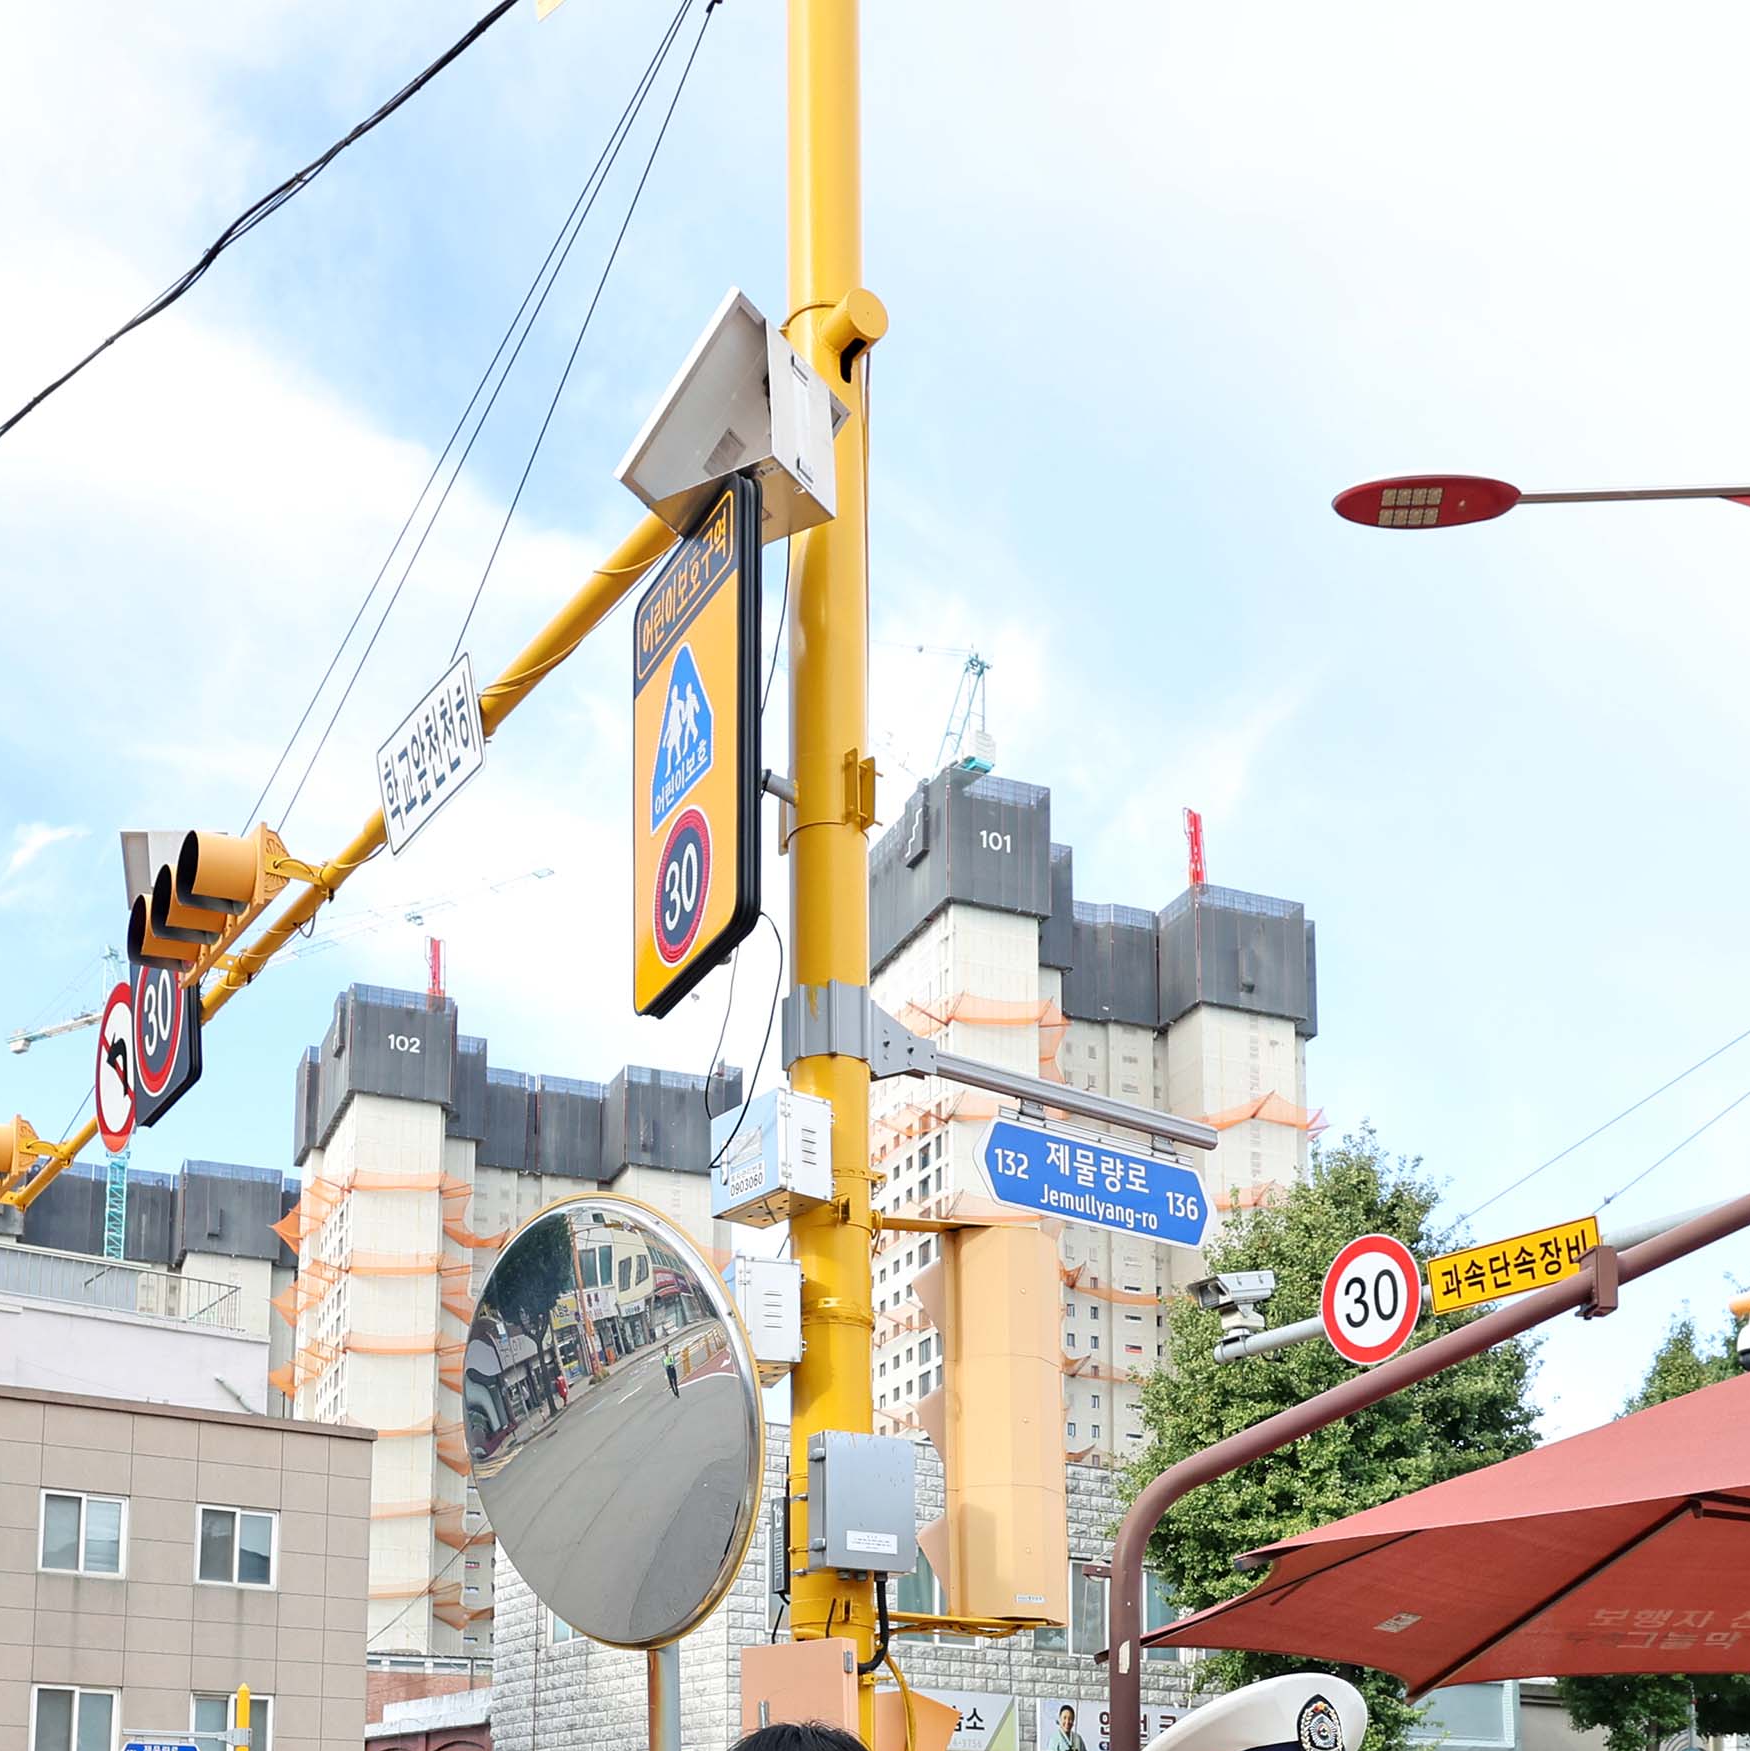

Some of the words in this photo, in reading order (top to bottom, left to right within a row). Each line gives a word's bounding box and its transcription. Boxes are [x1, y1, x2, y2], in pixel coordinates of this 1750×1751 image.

[642, 507, 728, 656] 어린이보호구역
[384, 671, 477, 830] 학교앞천천히
[655, 744, 708, 815] 어린이보호
[980, 830, 1011, 854] 101
[665, 842, 699, 931] 30
[144, 967, 172, 1057] 30
[387, 1034, 421, 1054] 102
[730, 1172, 763, 1197] 0903060
[995, 1146, 1030, 1181] 132
[1046, 1141, 1150, 1195] 제물량로
[1166, 1191, 1199, 1220] 136
[1039, 1183, 1159, 1231] Jemullyang-ro
[1344, 1268, 1399, 1329] 30
[1440, 1231, 1589, 1299] 과속단속장비
